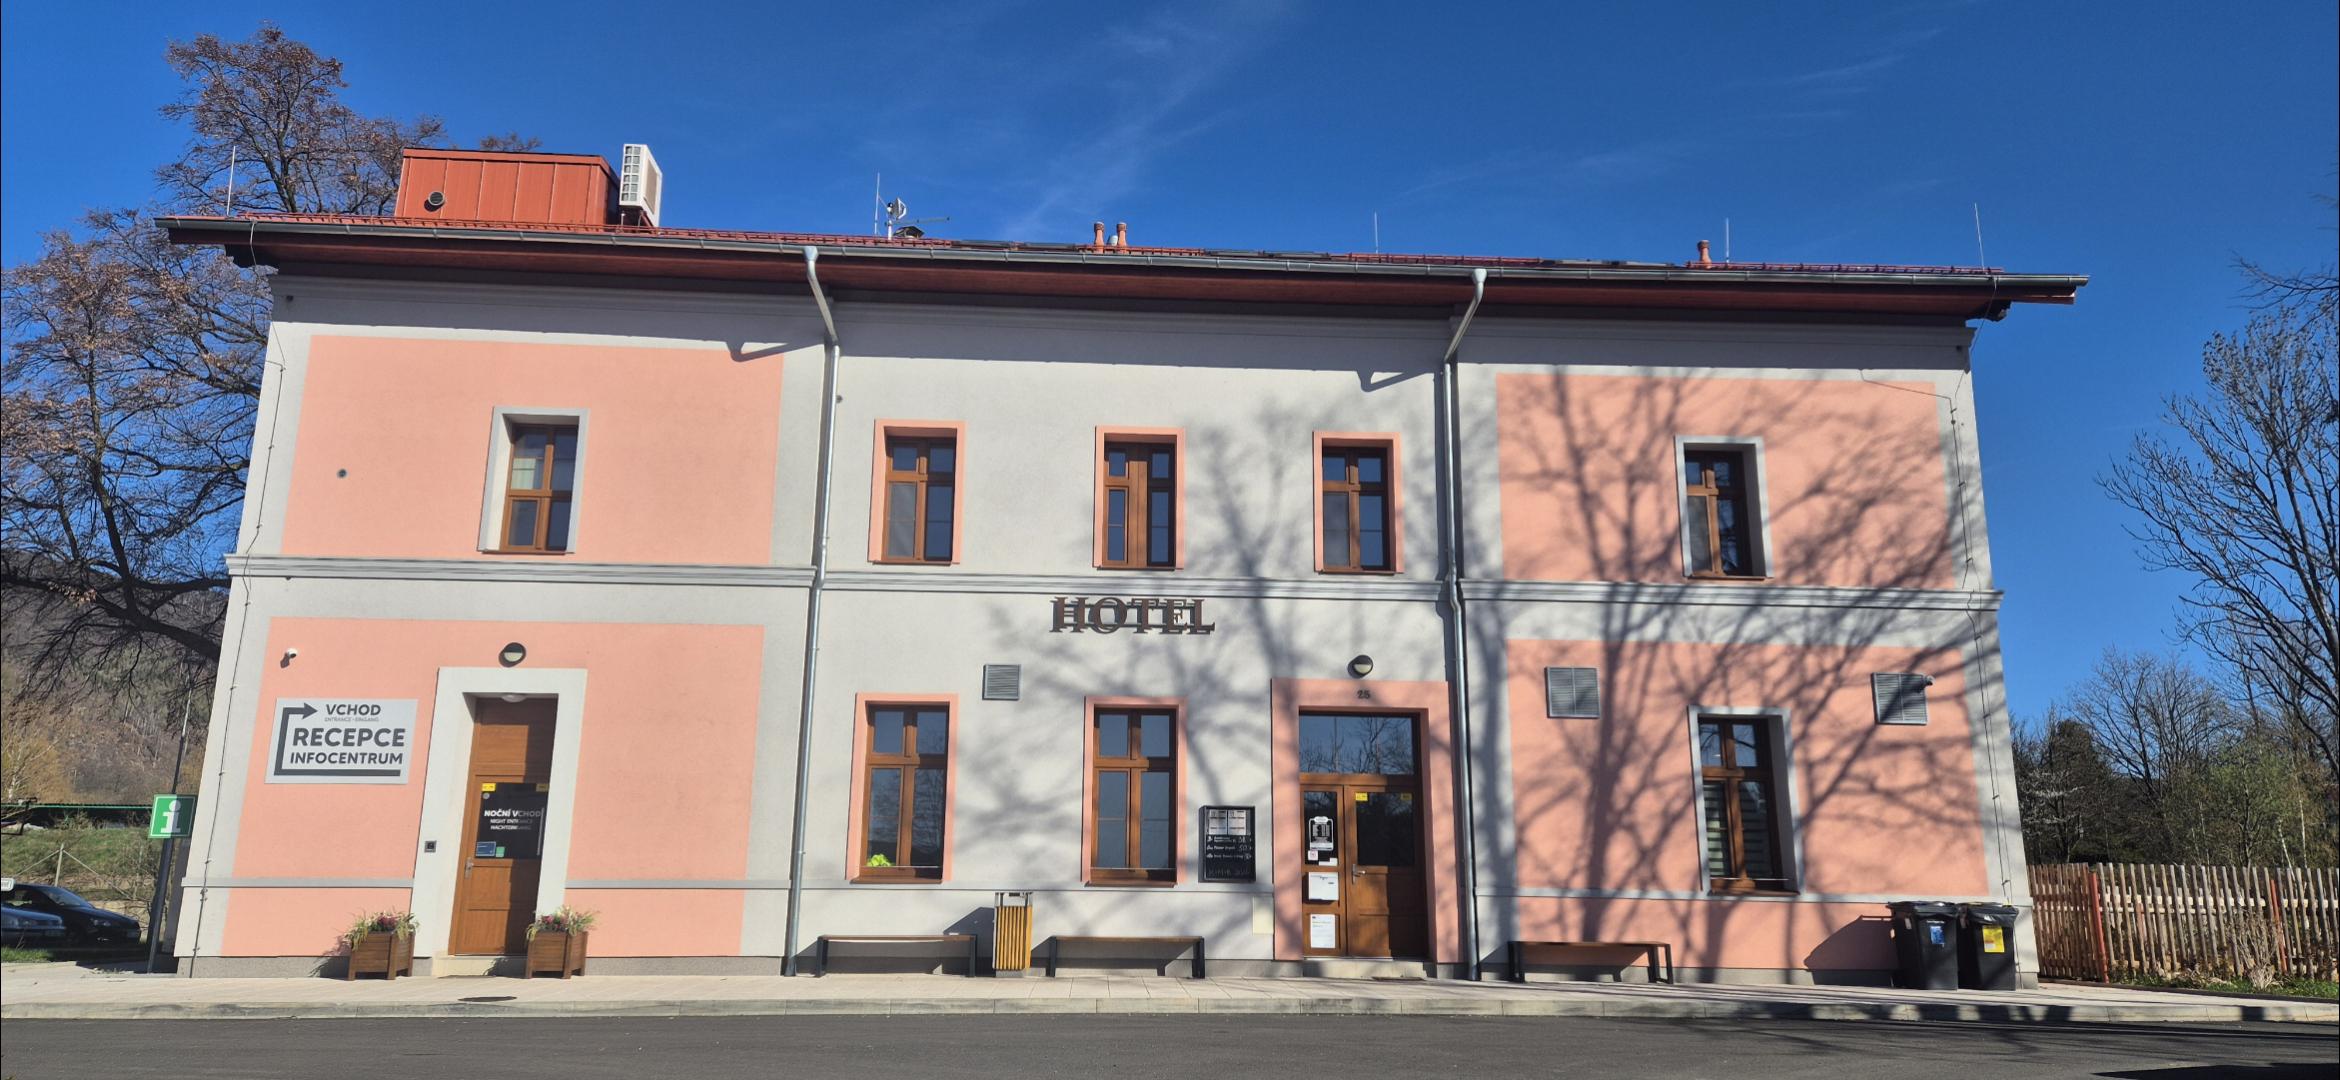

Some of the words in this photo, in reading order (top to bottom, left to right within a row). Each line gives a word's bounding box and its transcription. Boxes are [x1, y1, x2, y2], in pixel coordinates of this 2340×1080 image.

[1050, 596, 1215, 634] HOTEL
[326, 704, 381, 716] VCHOD
[292, 728, 405, 747] RECEPCE
[290, 752, 403, 765] INFOCENTRUM
[484, 809, 511, 817] NOČNÍ
